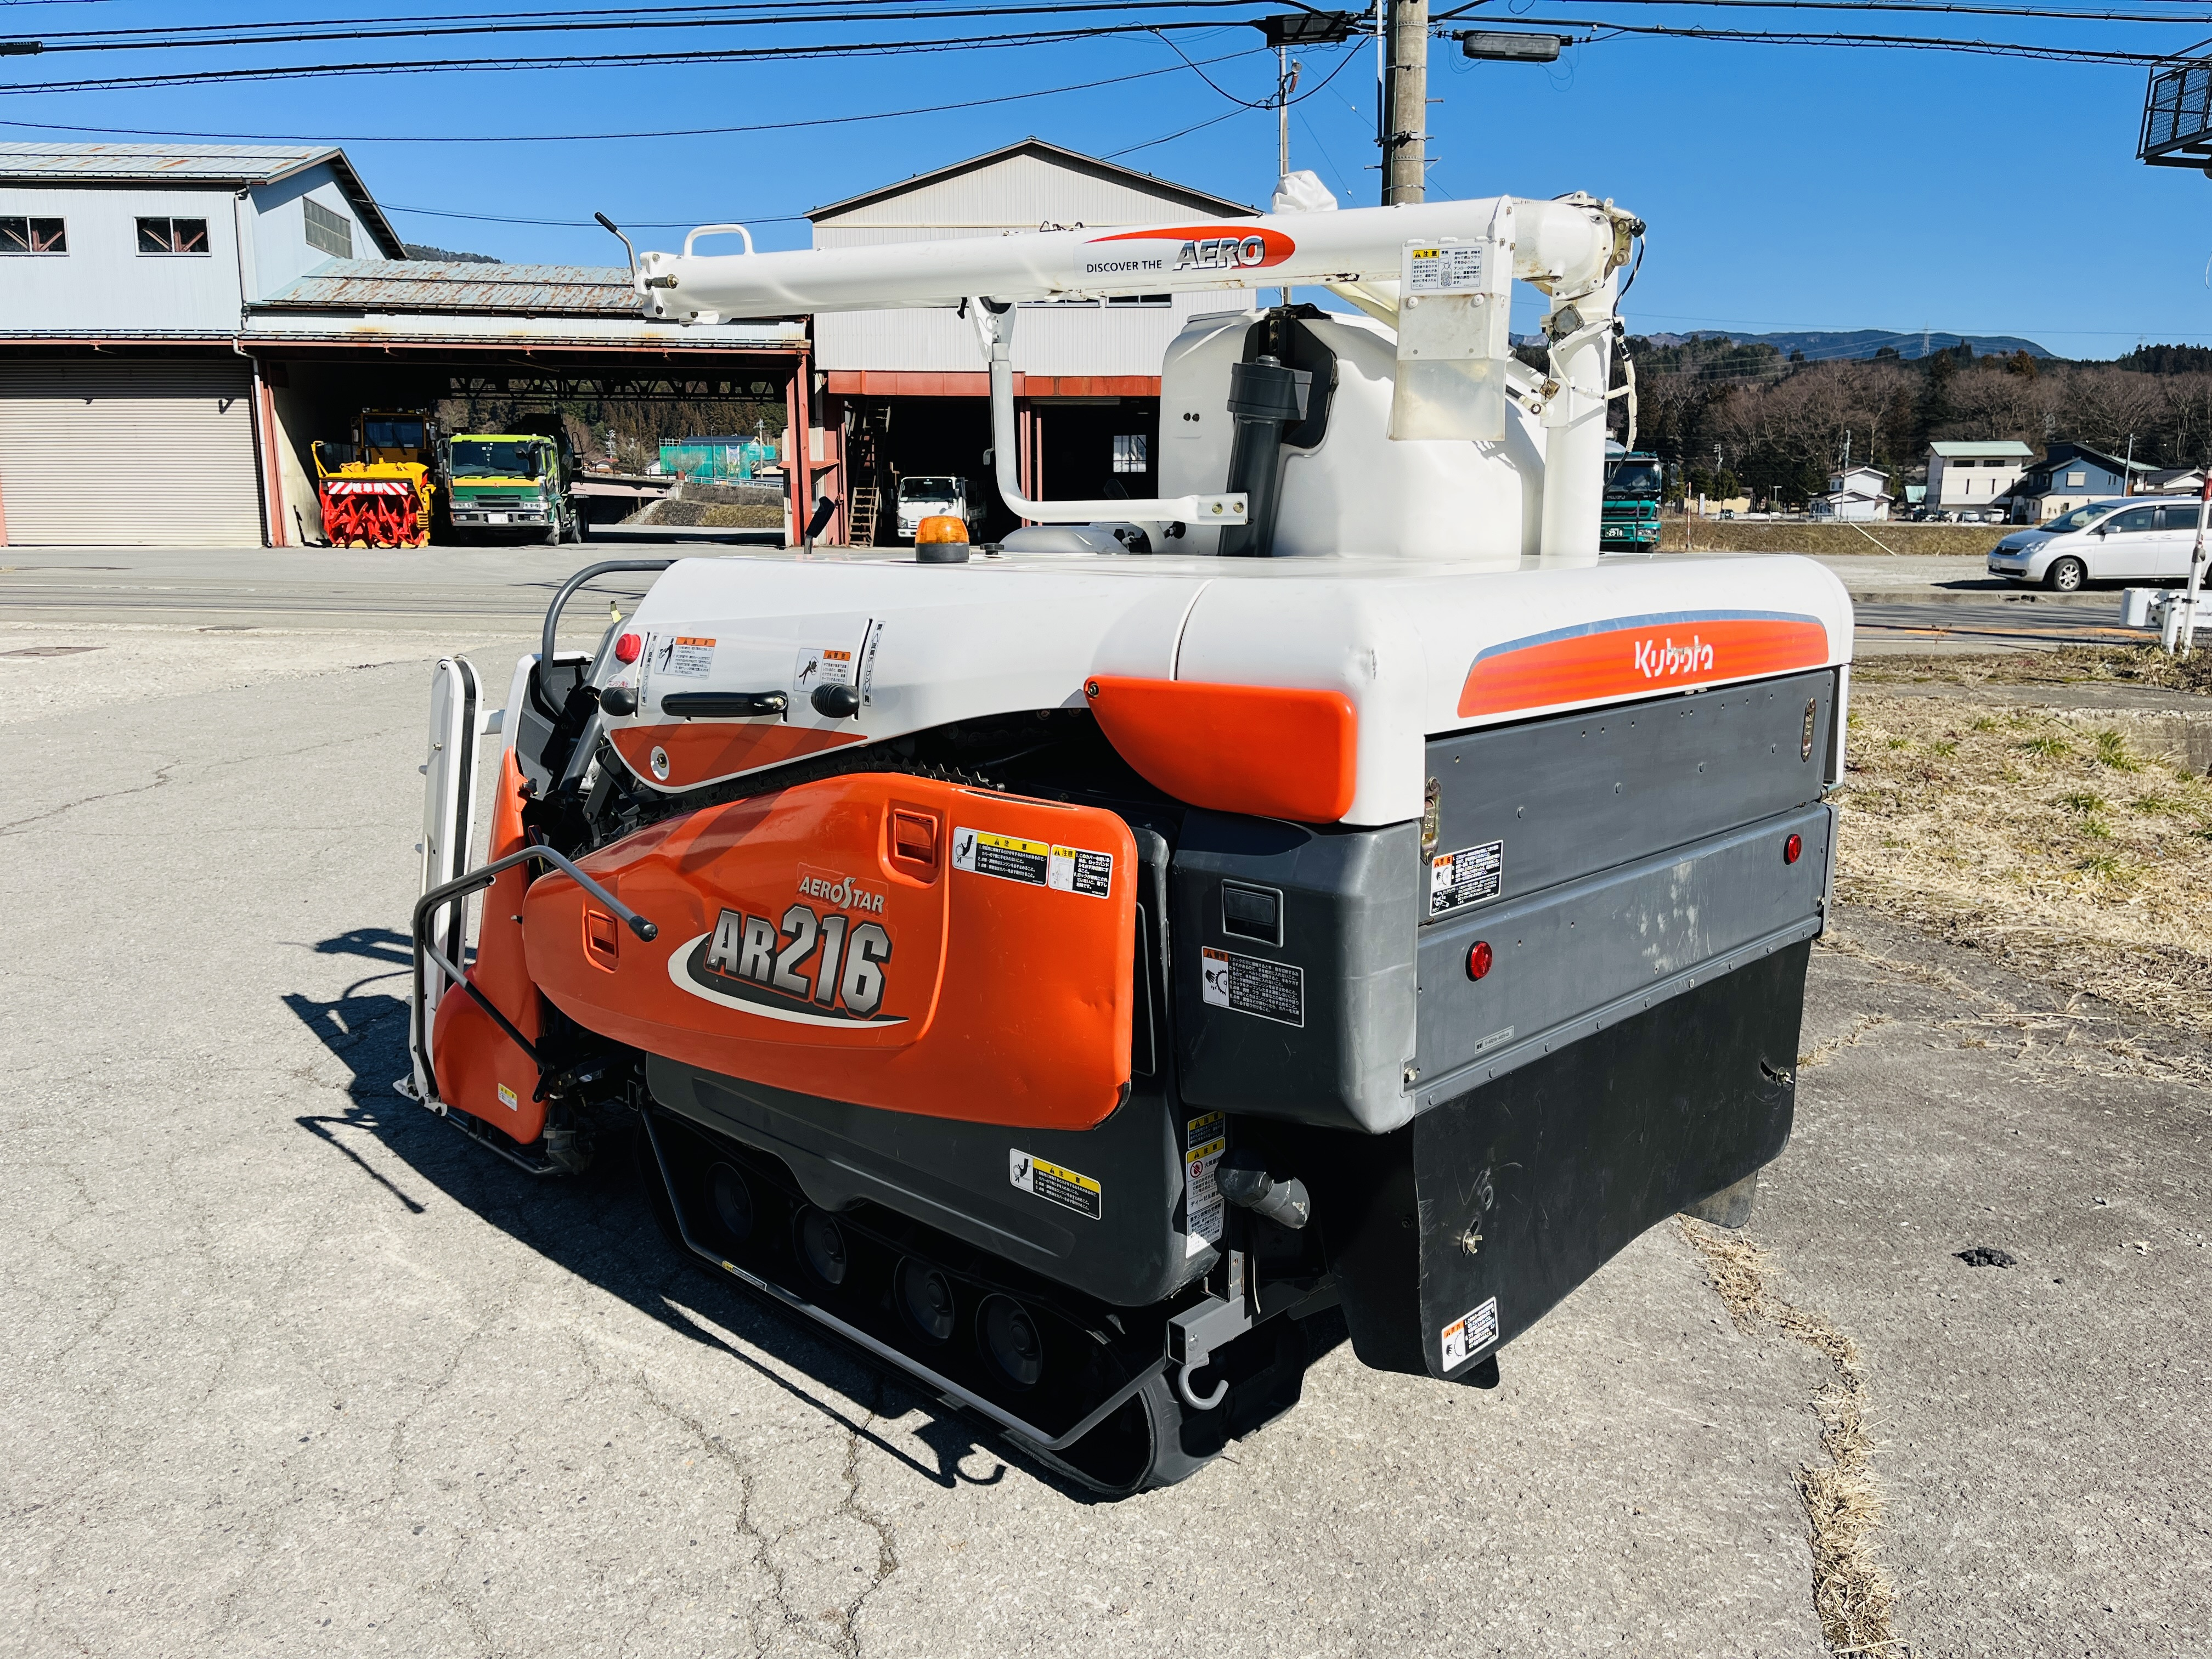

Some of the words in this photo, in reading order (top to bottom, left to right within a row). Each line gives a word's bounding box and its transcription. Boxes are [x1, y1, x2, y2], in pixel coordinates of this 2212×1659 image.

[1087, 262, 1139, 273] DISCOVER
[1142, 260, 1162, 269] THE
[1172, 235, 1265, 271] AERO
[1634, 635, 1714, 678] Kubota
[1003, 839, 1027, 850] 注意
[1062, 849, 1073, 857] 注意
[799, 877, 885, 913] AEROSTAR
[705, 902, 891, 1014] AR216
[1203, 1143, 1217, 1154] 注意
[1059, 1170, 1080, 1184] 注意
